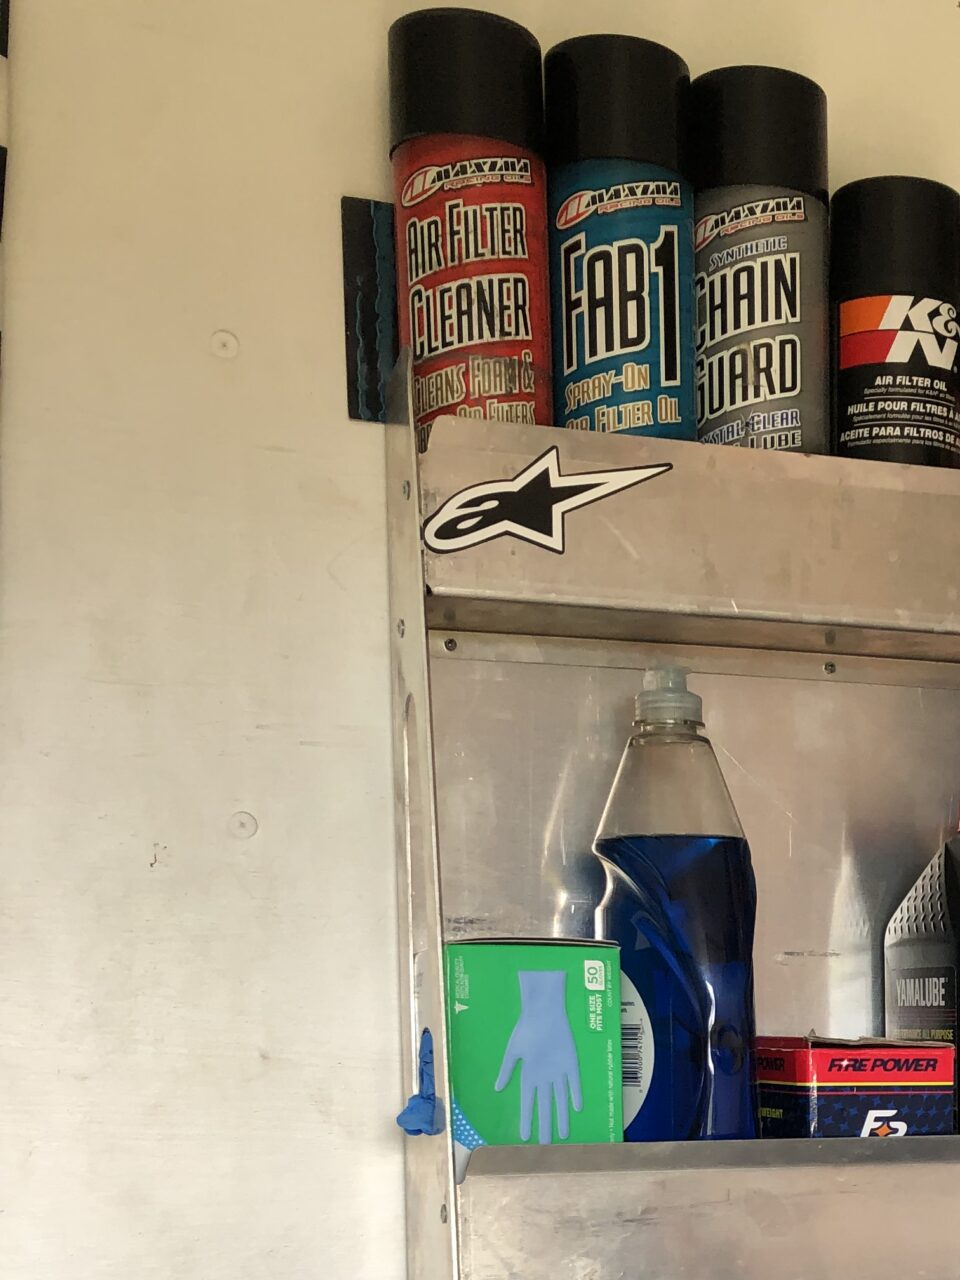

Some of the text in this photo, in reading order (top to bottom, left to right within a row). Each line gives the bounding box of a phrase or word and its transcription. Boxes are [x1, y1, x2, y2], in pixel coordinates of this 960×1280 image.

[406, 200, 528, 286] AIR FILTER
[709, 236, 787, 271] SYNTHETIC
[409, 273, 532, 363] CLEANER
[414, 363, 466, 417] CLEANS
[565, 362, 650, 415] SPRAY-ON
[874, 376, 948, 392] AIR FILTER OIL
[595, 395, 681, 433] FILTER OIL
[847, 402, 875, 416] HUILE
[877, 401, 908, 412] POUR
[910, 402, 948, 417] FILTRES
[700, 408, 801, 446] YSTAL CLEAR
[839, 428, 870, 443] ACEITE
[872, 426, 901, 437] PARA
[904, 427, 944, 441] FILTROS
[588, 966, 598, 985] 50
[896, 977, 946, 1007] YAMALUBE
[827, 1058, 938, 1072] FIRE POWER
